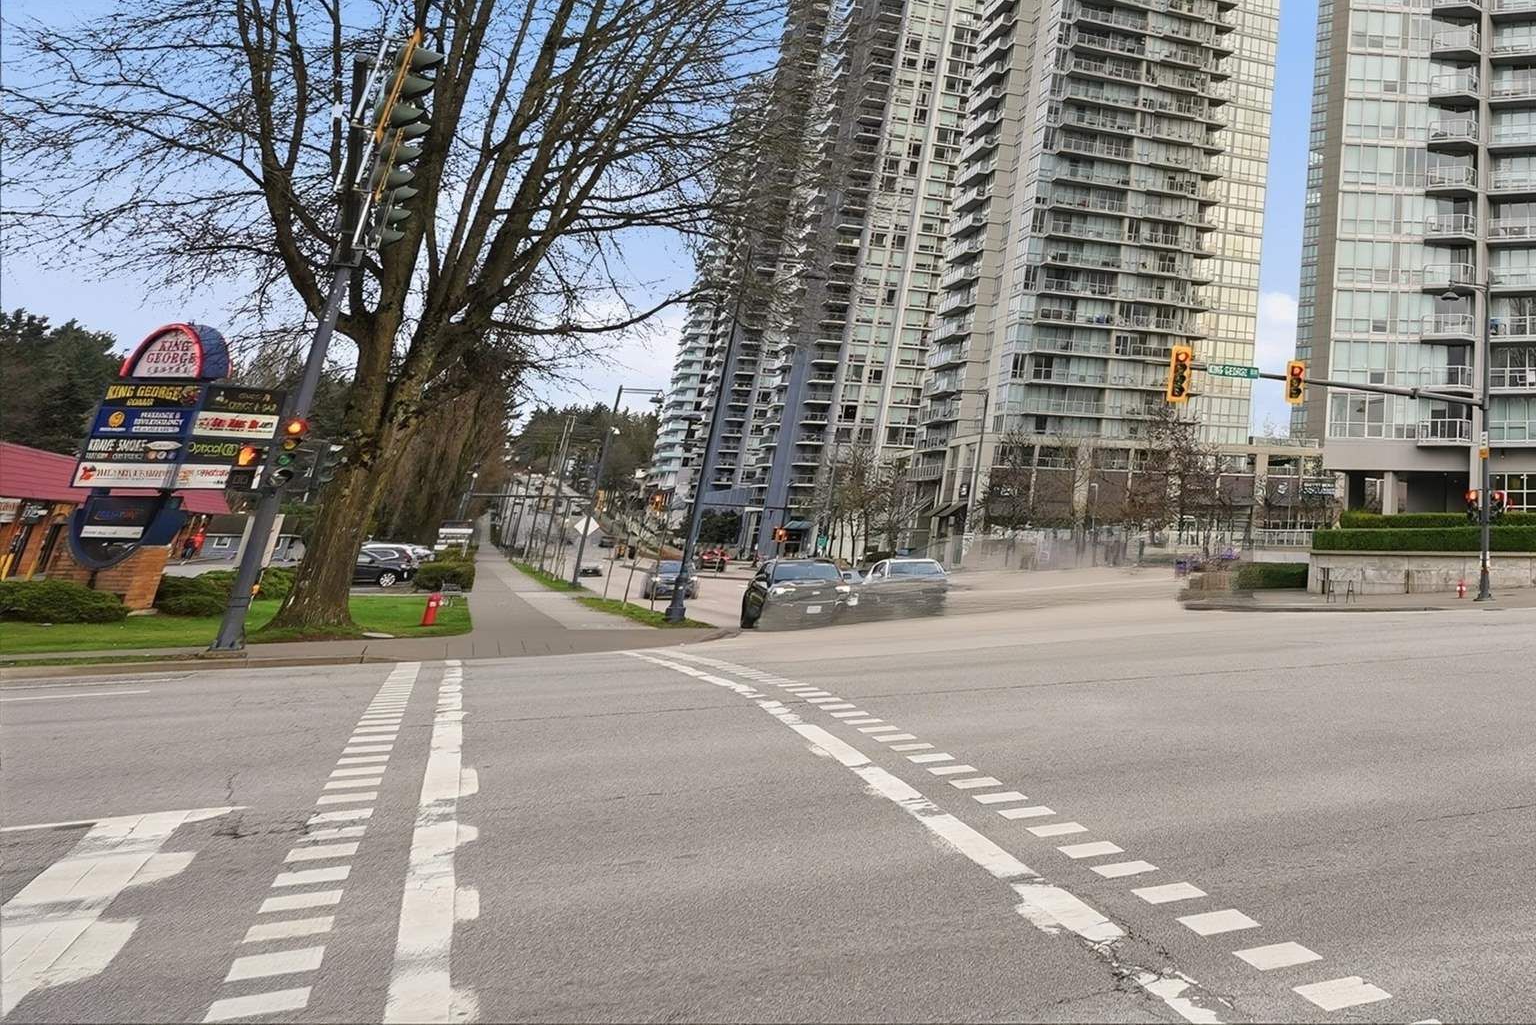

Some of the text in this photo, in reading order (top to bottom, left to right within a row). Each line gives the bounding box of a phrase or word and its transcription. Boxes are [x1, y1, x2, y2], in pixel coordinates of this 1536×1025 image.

[160, 340, 193, 352] KING
[146, 352, 197, 364] GEORGE
[105, 385, 182, 401] KING GEORGE
